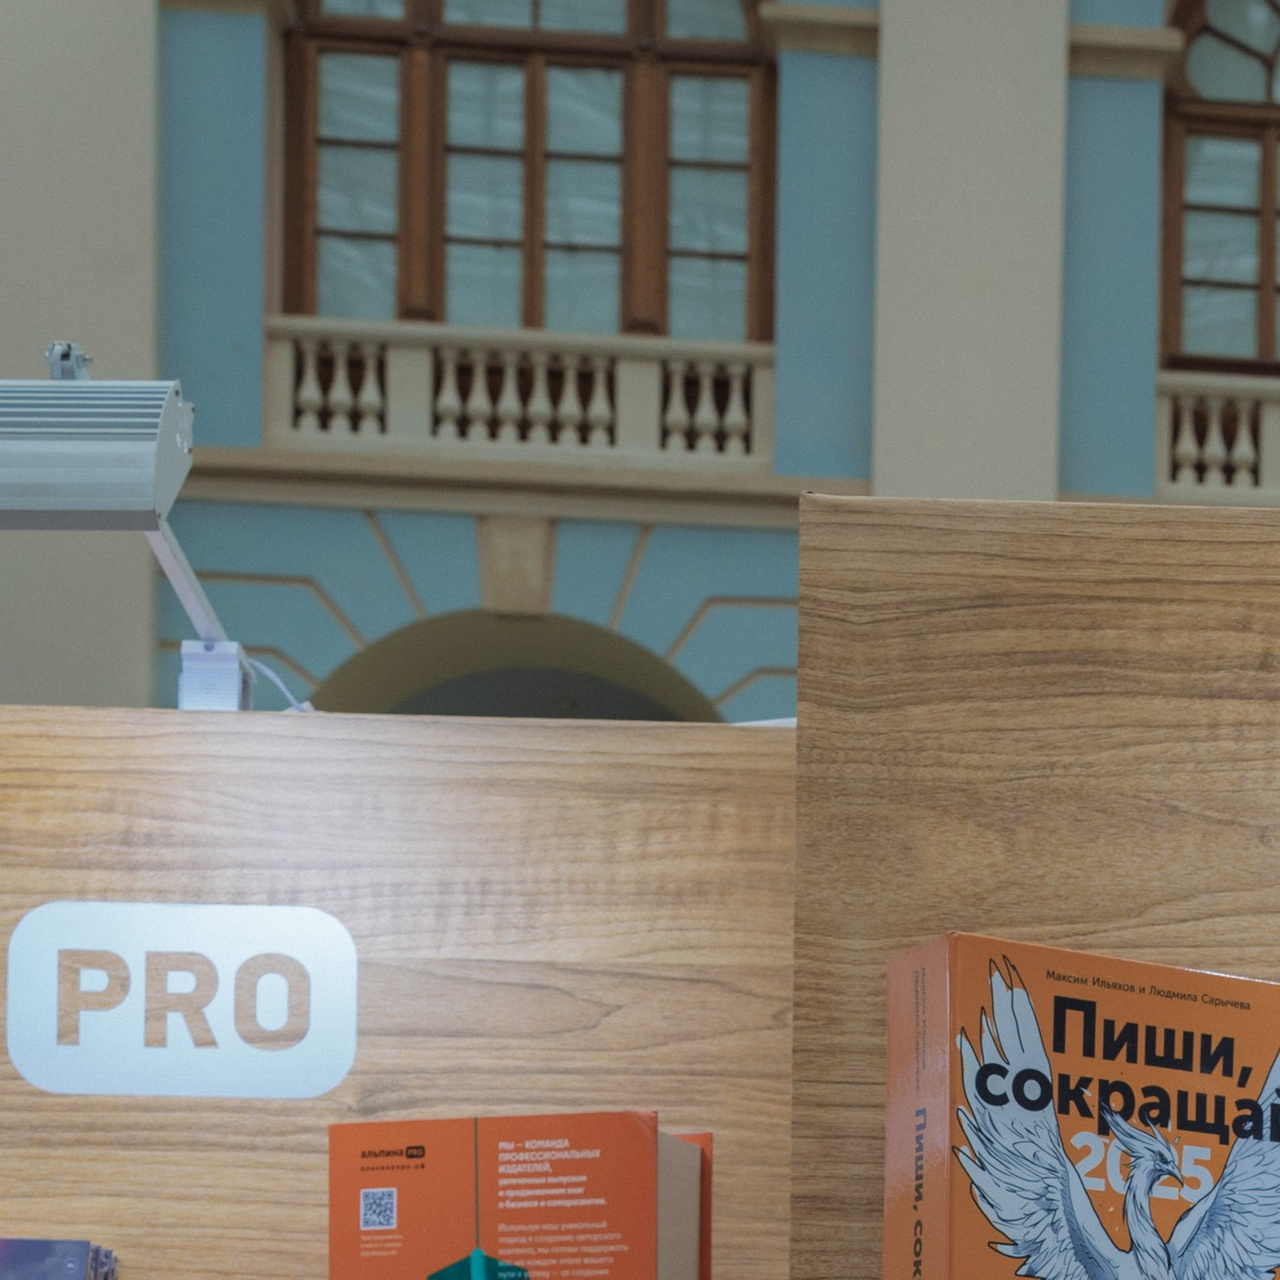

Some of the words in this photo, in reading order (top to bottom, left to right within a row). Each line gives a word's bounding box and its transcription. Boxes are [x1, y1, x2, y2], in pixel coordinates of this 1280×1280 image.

[56, 948, 311, 1052] PRO
[1046, 969, 1088, 986] Максим
[1091, 976, 1136, 994] Ильяхов
[1138, 986, 1145, 994] и
[1149, 984, 1198, 1003] Людмила
[1201, 992, 1251, 1011] Сарычева
[1052, 995, 1253, 1088] Пиши,
[912, 1107, 927, 1212] Пиши,
